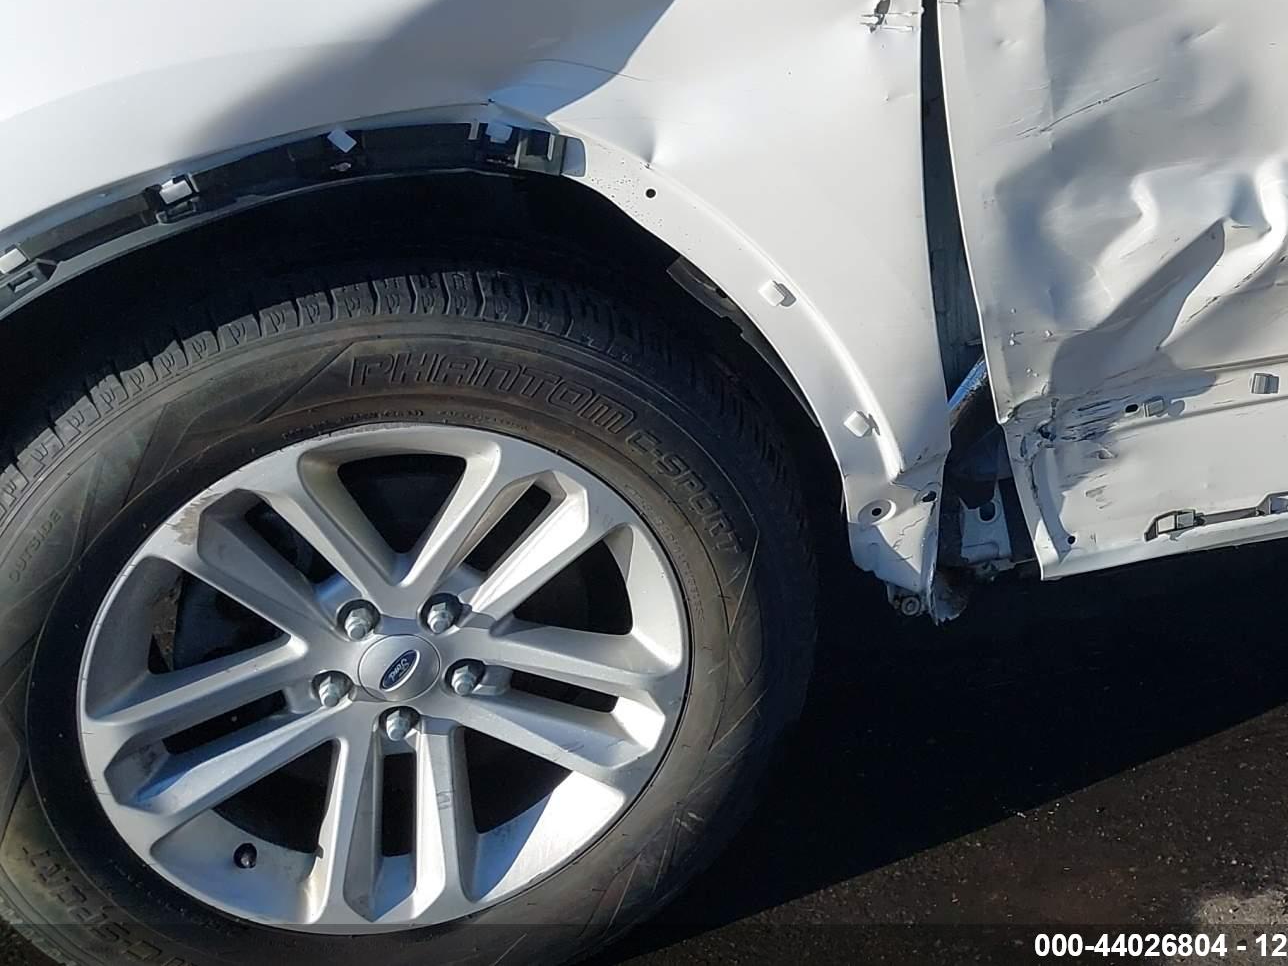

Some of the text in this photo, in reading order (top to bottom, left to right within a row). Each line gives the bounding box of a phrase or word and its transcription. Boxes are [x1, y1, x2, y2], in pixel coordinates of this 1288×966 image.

[348, 352, 638, 434] PHANTOM
[625, 428, 742, 555] C-SPORT
[8, 509, 62, 583] OUTSIDE
